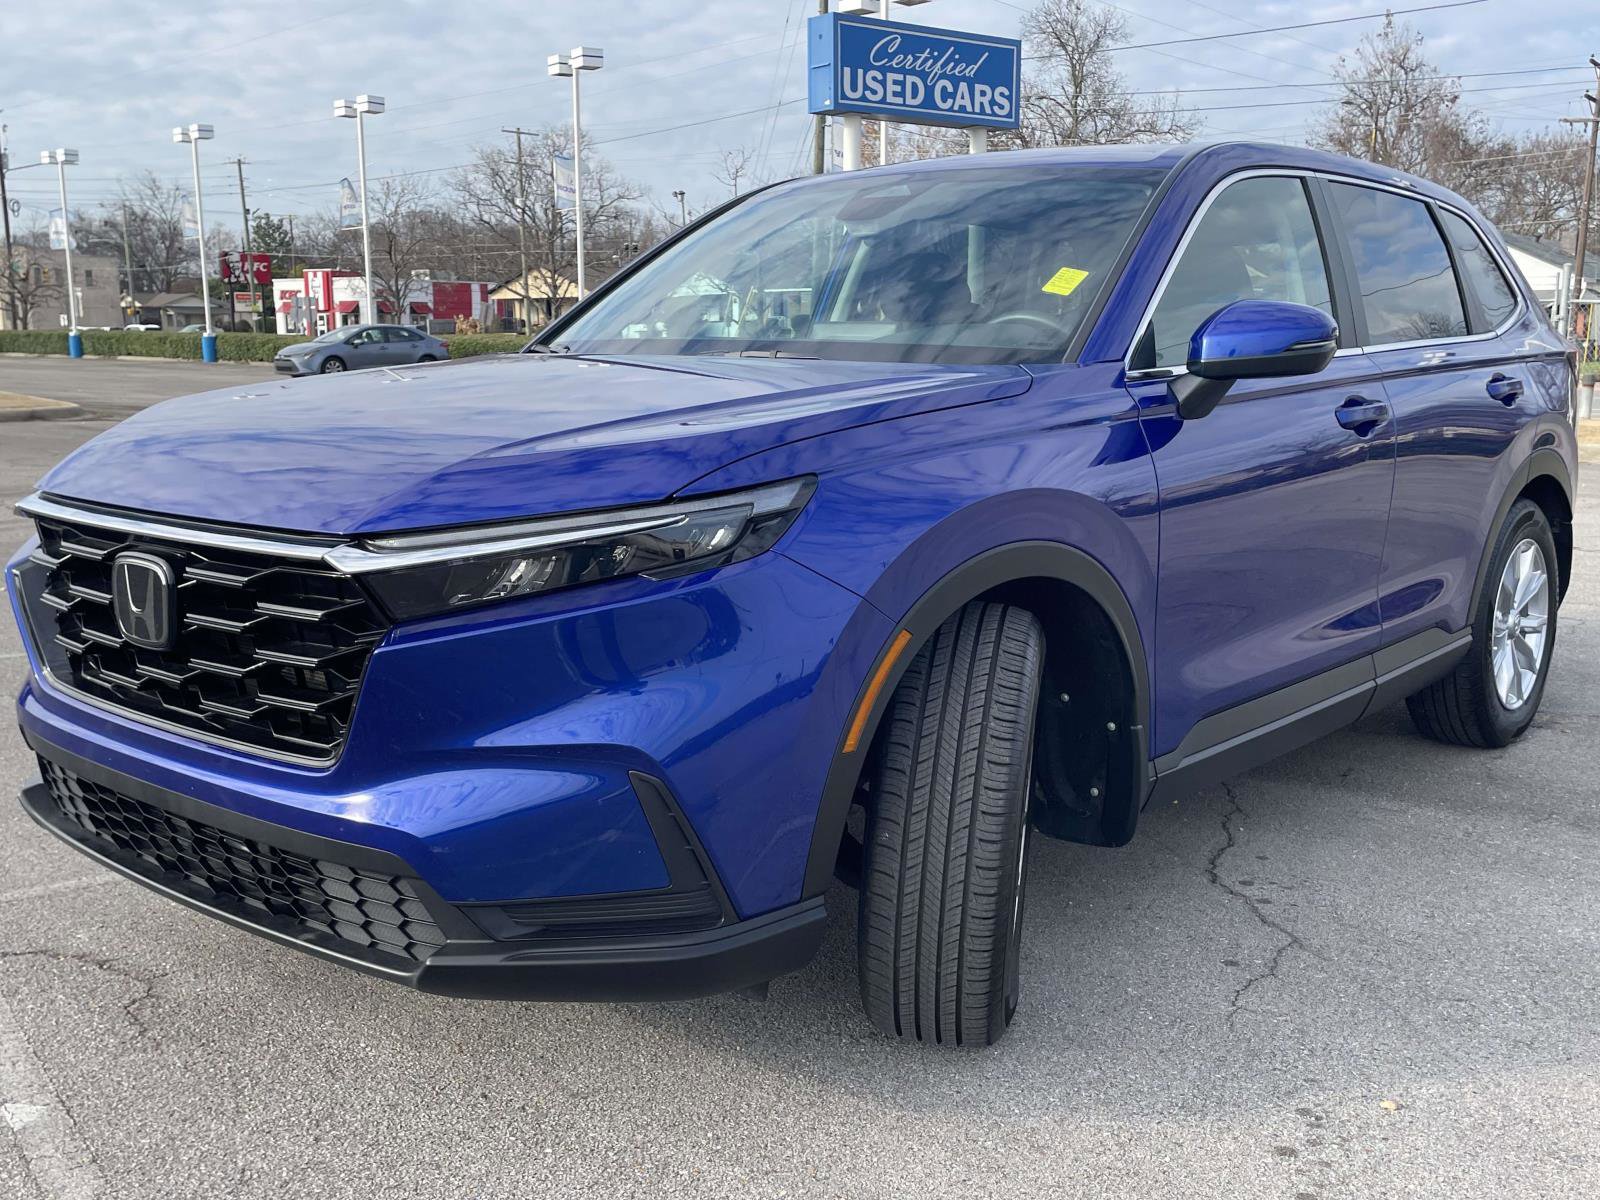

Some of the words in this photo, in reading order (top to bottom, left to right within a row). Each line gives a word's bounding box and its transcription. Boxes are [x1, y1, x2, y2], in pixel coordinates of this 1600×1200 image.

[869, 34, 989, 86] Certified
[843, 67, 925, 106] USED
[934, 79, 1010, 116] CARS
